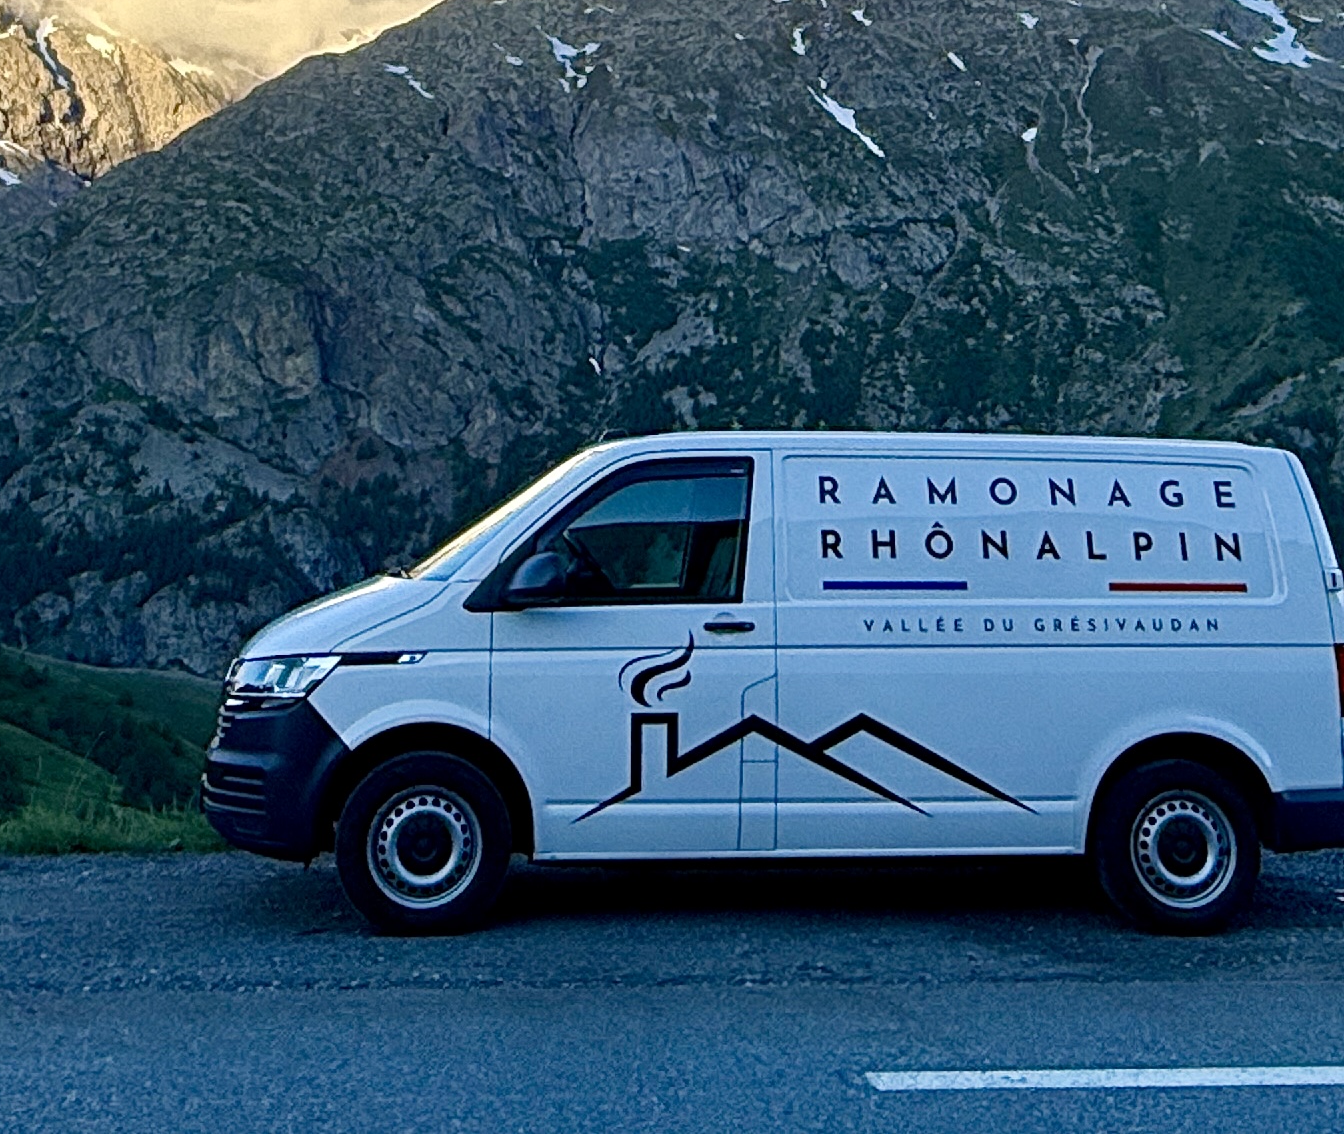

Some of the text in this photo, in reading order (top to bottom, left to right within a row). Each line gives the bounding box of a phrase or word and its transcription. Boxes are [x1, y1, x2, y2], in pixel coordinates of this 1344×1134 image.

[818, 475, 1237, 509] RAMONAGE
[820, 520, 1243, 563] RHÔNALPIN
[862, 615, 1220, 633] VALLÉE DU GRÉSIVAUDAN
